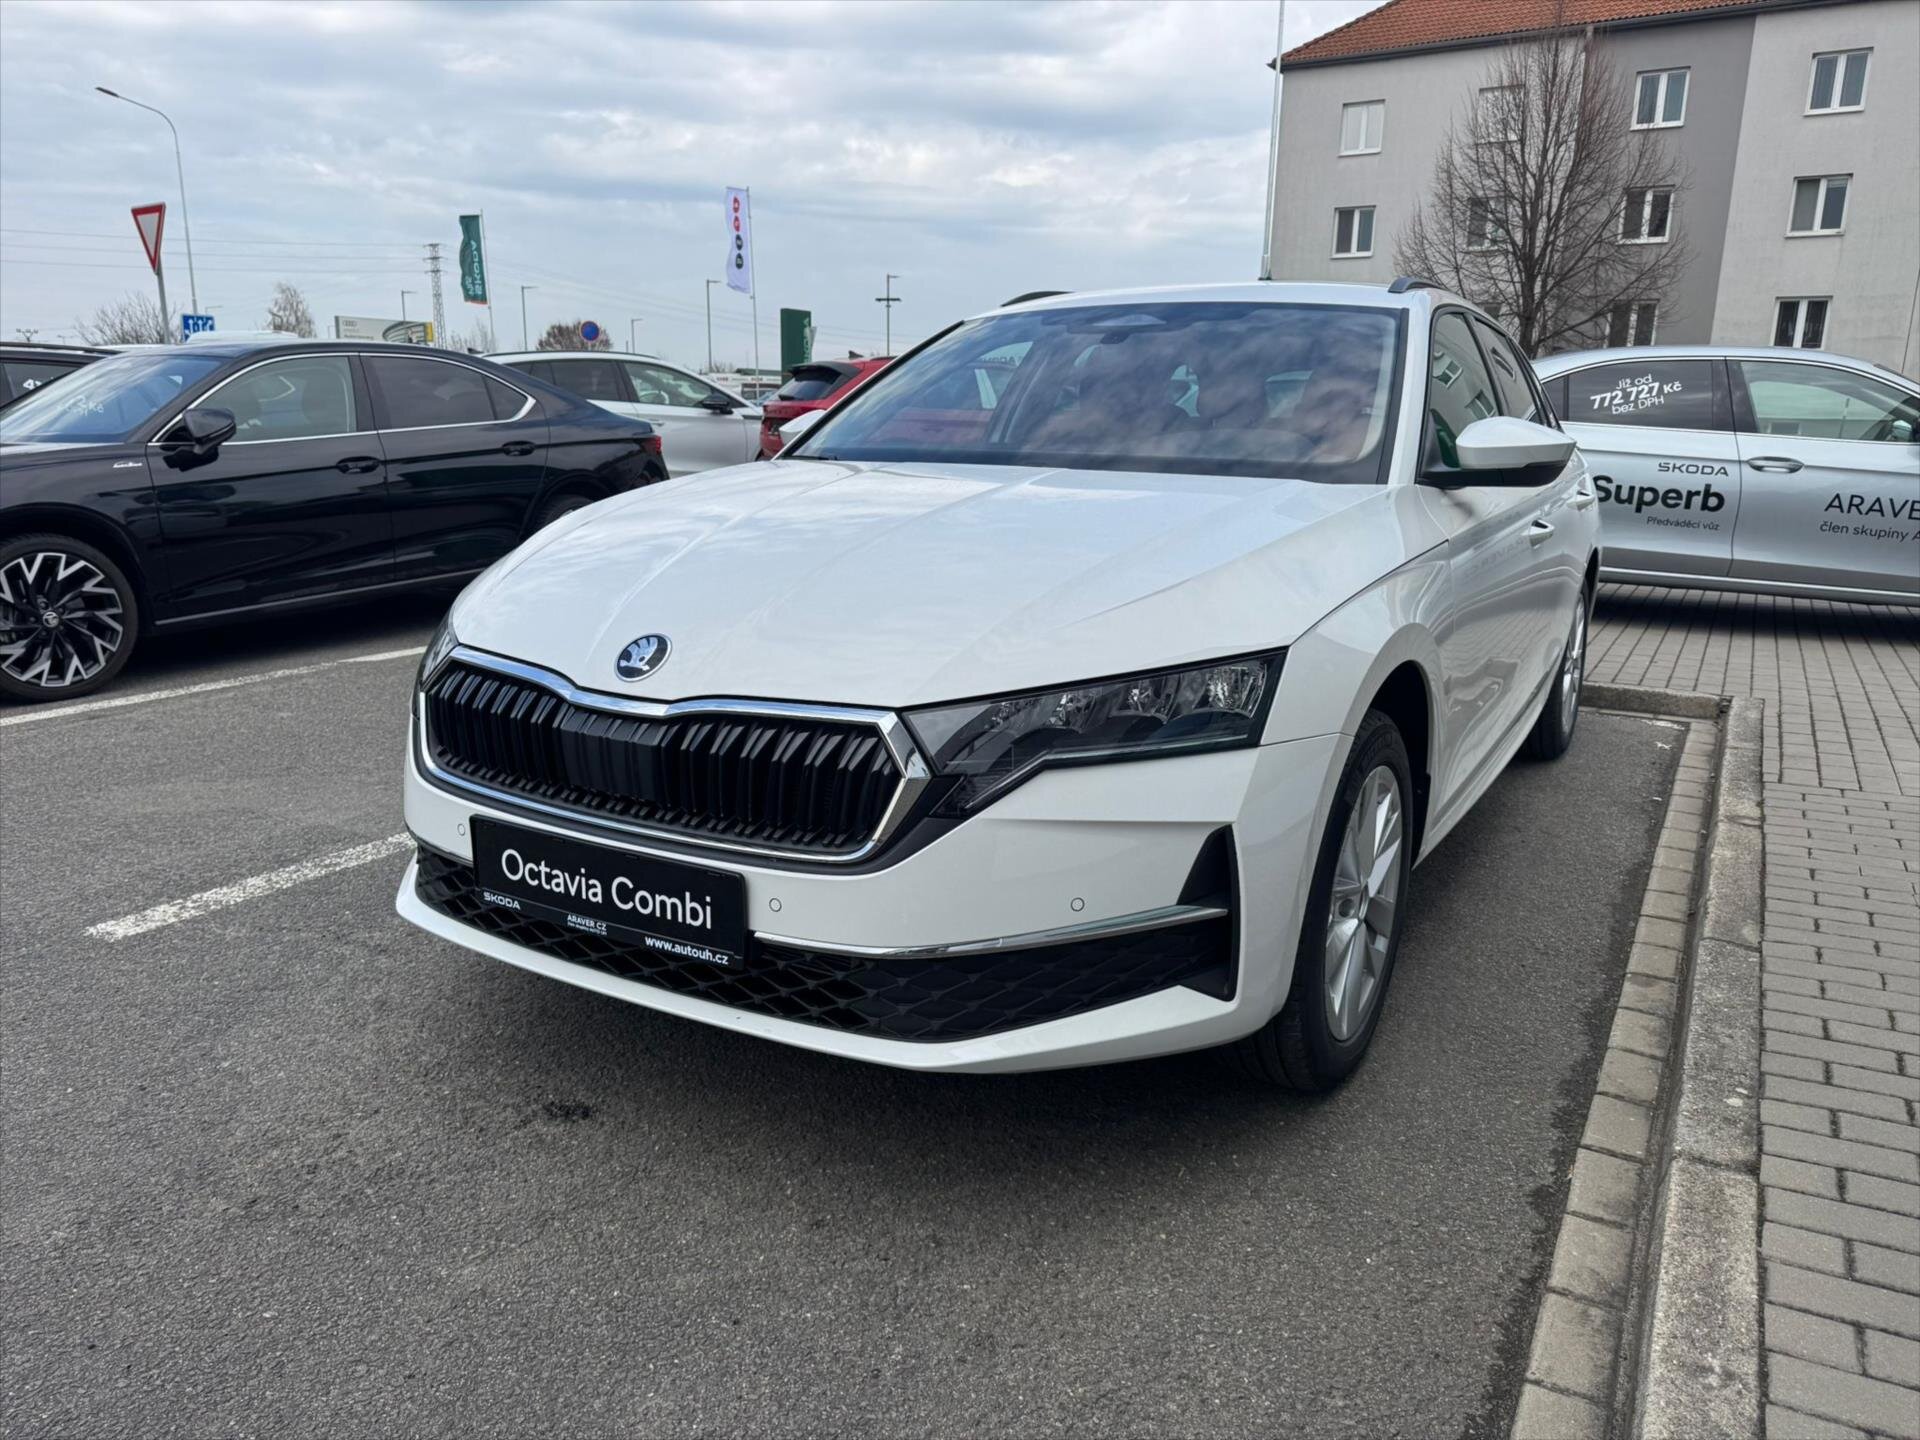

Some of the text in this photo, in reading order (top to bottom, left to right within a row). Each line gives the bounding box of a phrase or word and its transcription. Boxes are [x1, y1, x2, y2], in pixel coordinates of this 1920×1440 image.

[1635, 373, 1652, 385] od
[1590, 381, 1682, 409] 772 727 Kč
[1612, 395, 1664, 414] bez DPH
[1592, 474, 1725, 513] Superb
[1646, 515, 1720, 531] Předváděcí vůz
[1820, 520, 1849, 535] člen
[1852, 525, 1909, 543] skupiny
[501, 848, 711, 930] Octavia Combi
[567, 914, 595, 928] ARAVER
[596, 922, 607, 931] CZ
[645, 936, 729, 965] www.autouh.cz
